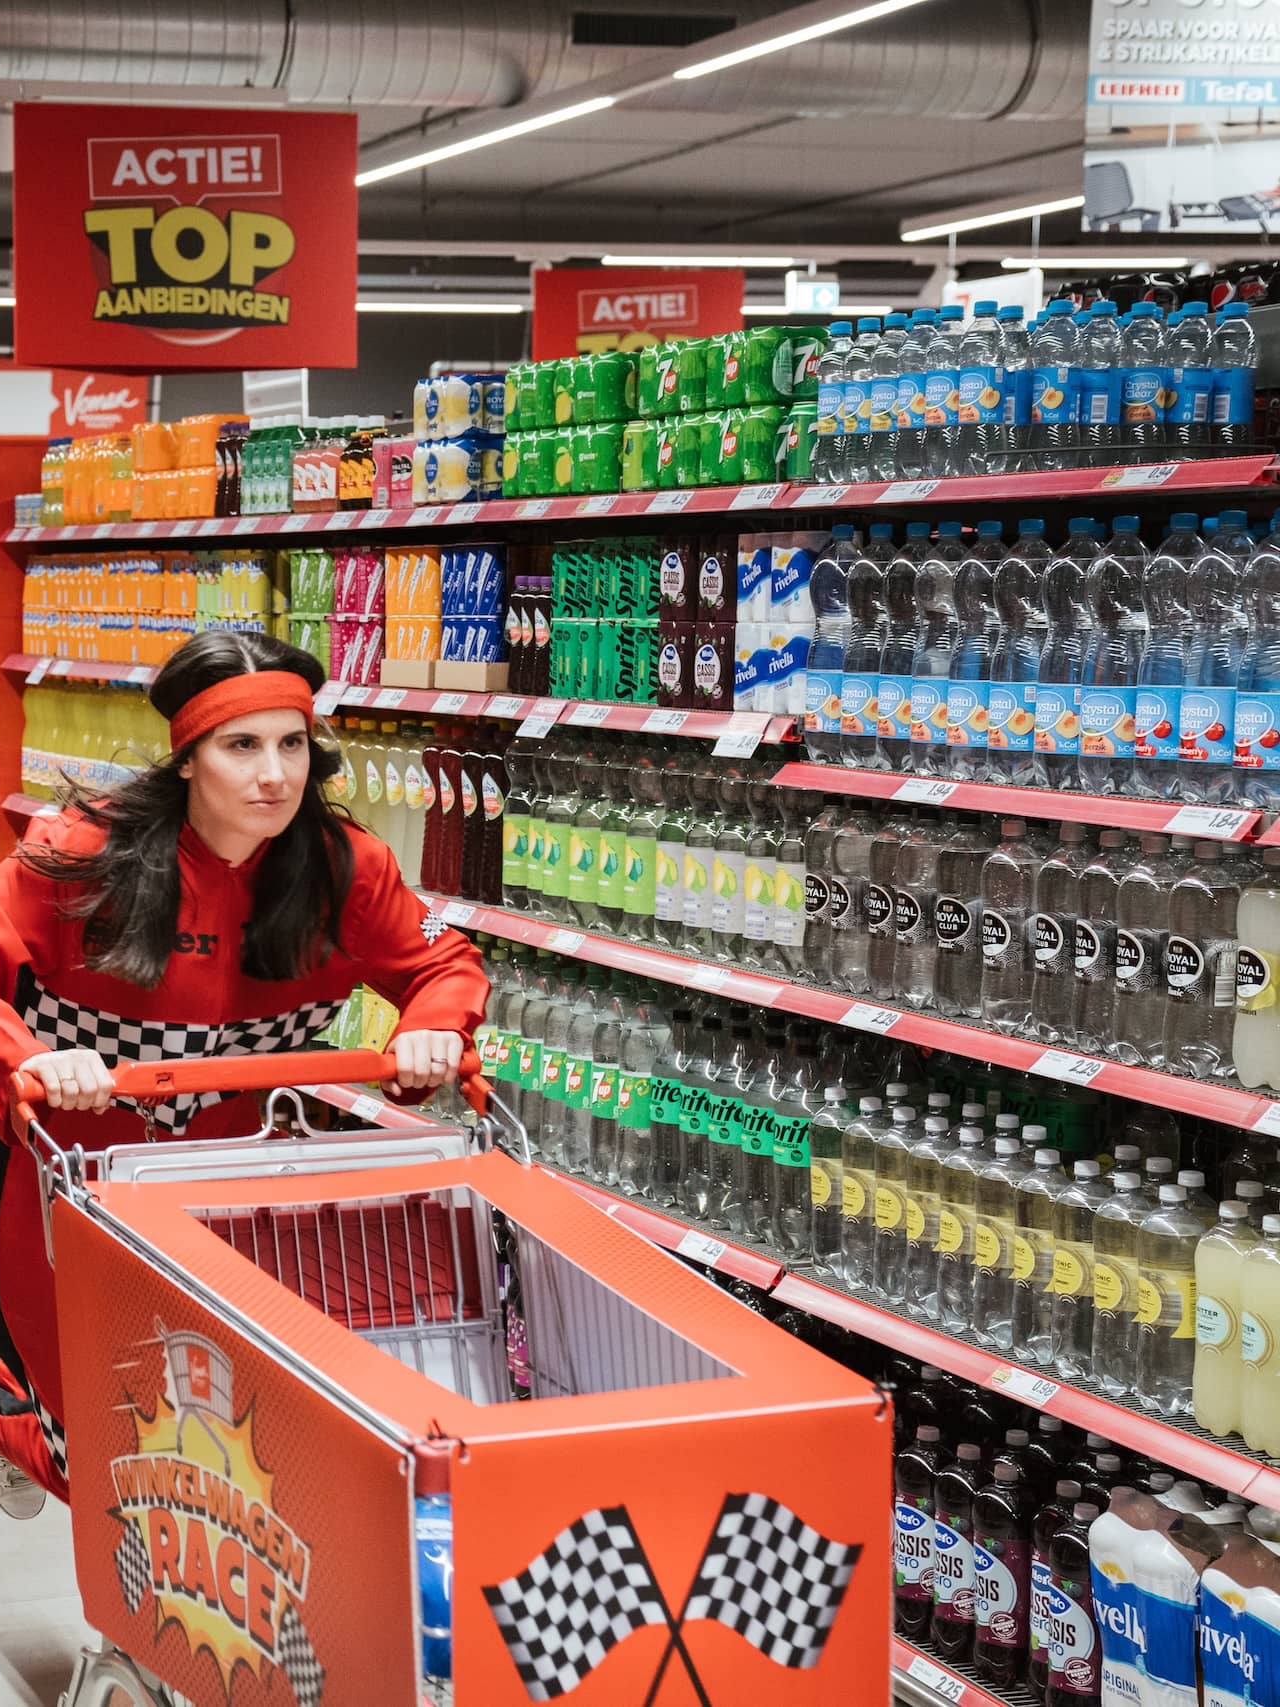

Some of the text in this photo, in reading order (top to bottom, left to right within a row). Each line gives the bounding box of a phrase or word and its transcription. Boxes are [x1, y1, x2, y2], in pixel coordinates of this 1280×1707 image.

[1099, 83, 1180, 97] LEIFHEIT
[111, 146, 263, 187] ACTIE!
[83, 206, 296, 287] TOP
[93, 287, 291, 324] AANBIEDINGEN
[592, 292, 687, 322] ACTIE!
[1124, 380, 1159, 392] Crystal
[1125, 390, 1152, 399] Clear
[774, 567, 799, 593] rivella
[768, 651, 794, 674] rivella
[1082, 702, 1120, 717] Crystal
[1082, 715, 1109, 726] Clear
[1235, 711, 1268, 725] rystal
[1235, 723, 1258, 736] lear
[832, 893, 847, 904] YAL
[870, 900, 888, 910] OYAL
[897, 906, 917, 917] OYAL
[936, 911, 968, 924] ROYAL
[938, 922, 958, 931] CLUB
[983, 927, 1005, 937] OYAL
[1036, 929, 1057, 942] OYAL
[1117, 946, 1138, 959] OYAL
[1169, 965, 1187, 974] CLUB
[1237, 963, 1264, 977] OYAL
[592, 1071, 612, 1104] 7up
[651, 1080, 680, 1103] rite
[113, 1457, 307, 1588] WINKELWAGEN
[896, 1531, 931, 1558] ASSIS
[936, 1530, 954, 1545] ero
[936, 1550, 964, 1579] SSIS
[148, 1506, 278, 1657] RACE
[935, 1574, 952, 1589] ero
[934, 1675, 963, 1700] 2.25
